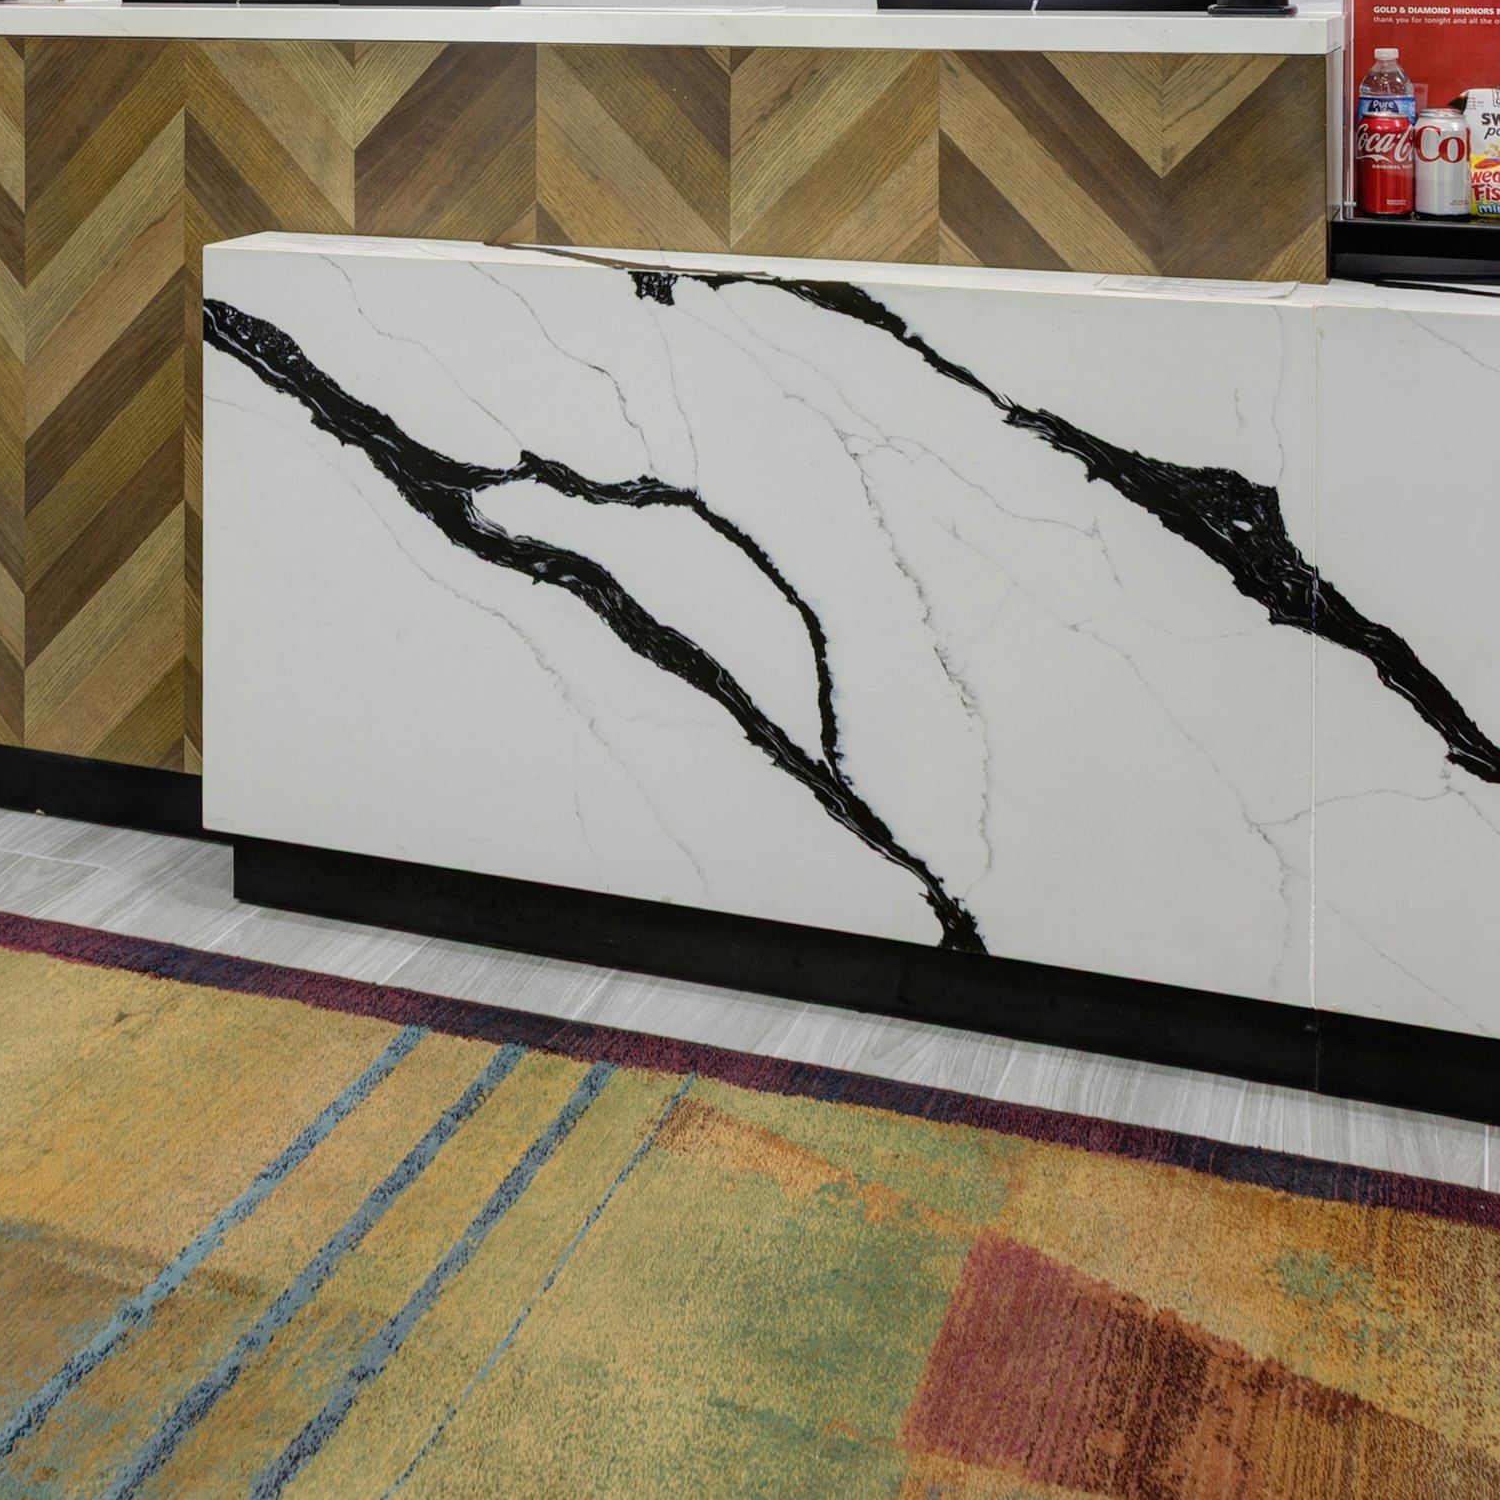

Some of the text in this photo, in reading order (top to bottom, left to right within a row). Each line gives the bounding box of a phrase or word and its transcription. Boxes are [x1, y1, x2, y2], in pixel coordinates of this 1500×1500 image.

[1373, 6, 1397, 14] GOLD
[1408, 6, 1450, 15] DIAMOND
[1453, 7, 1494, 15] HHONORS
[1411, 16, 1422, 24] for
[1424, 17, 1451, 26] tonight
[1453, 17, 1467, 25] and
[1469, 17, 1478, 25] all
[1480, 17, 1492, 25] the
[1372, 100, 1394, 108] Pure
